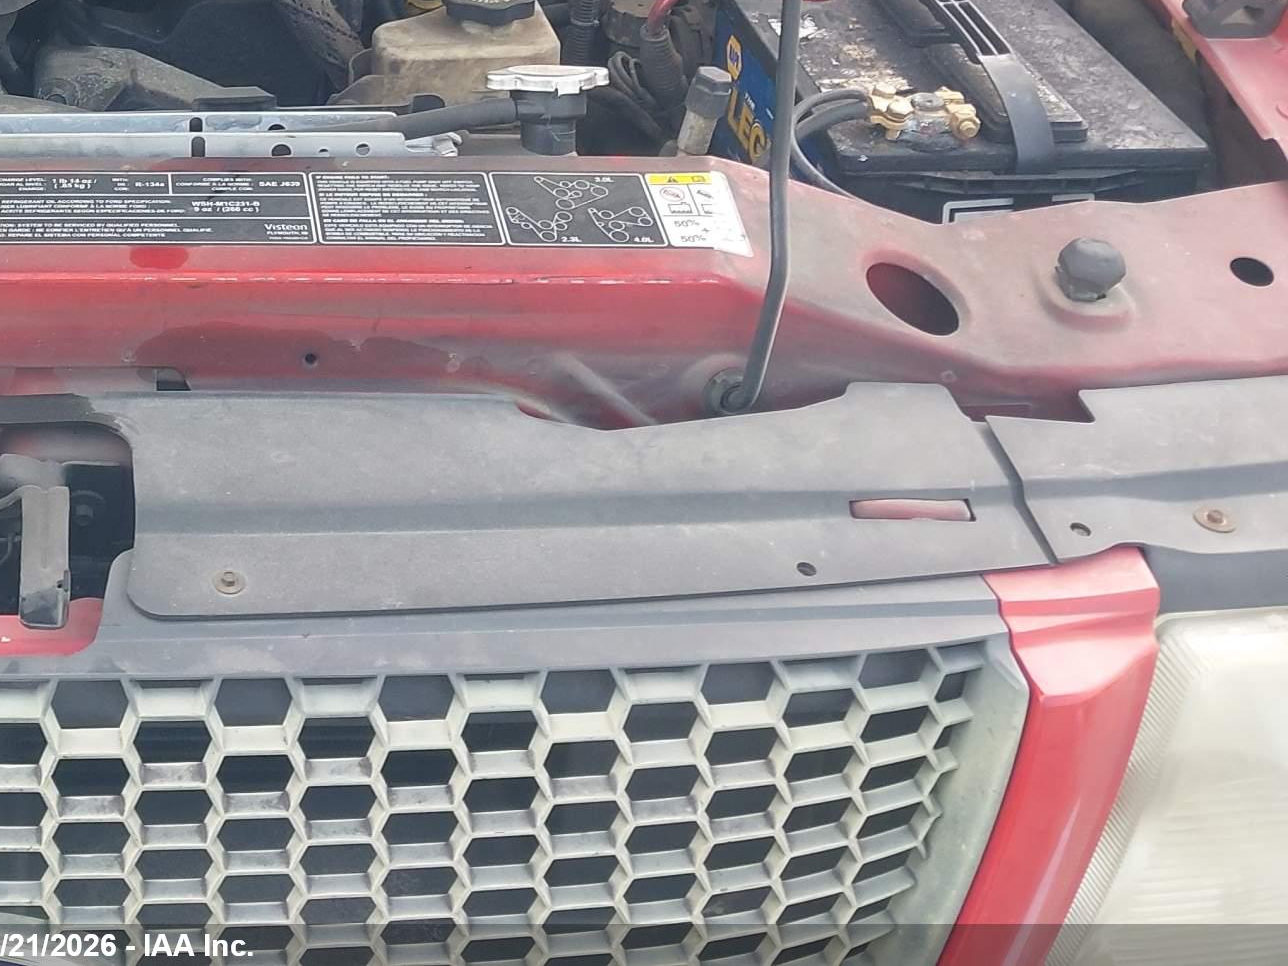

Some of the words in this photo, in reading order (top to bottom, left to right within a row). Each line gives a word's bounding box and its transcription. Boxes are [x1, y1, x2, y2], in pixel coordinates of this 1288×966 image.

[264, 223, 309, 231] Visteon
[674, 219, 701, 227] 50%
[680, 234, 707, 243] 50%
